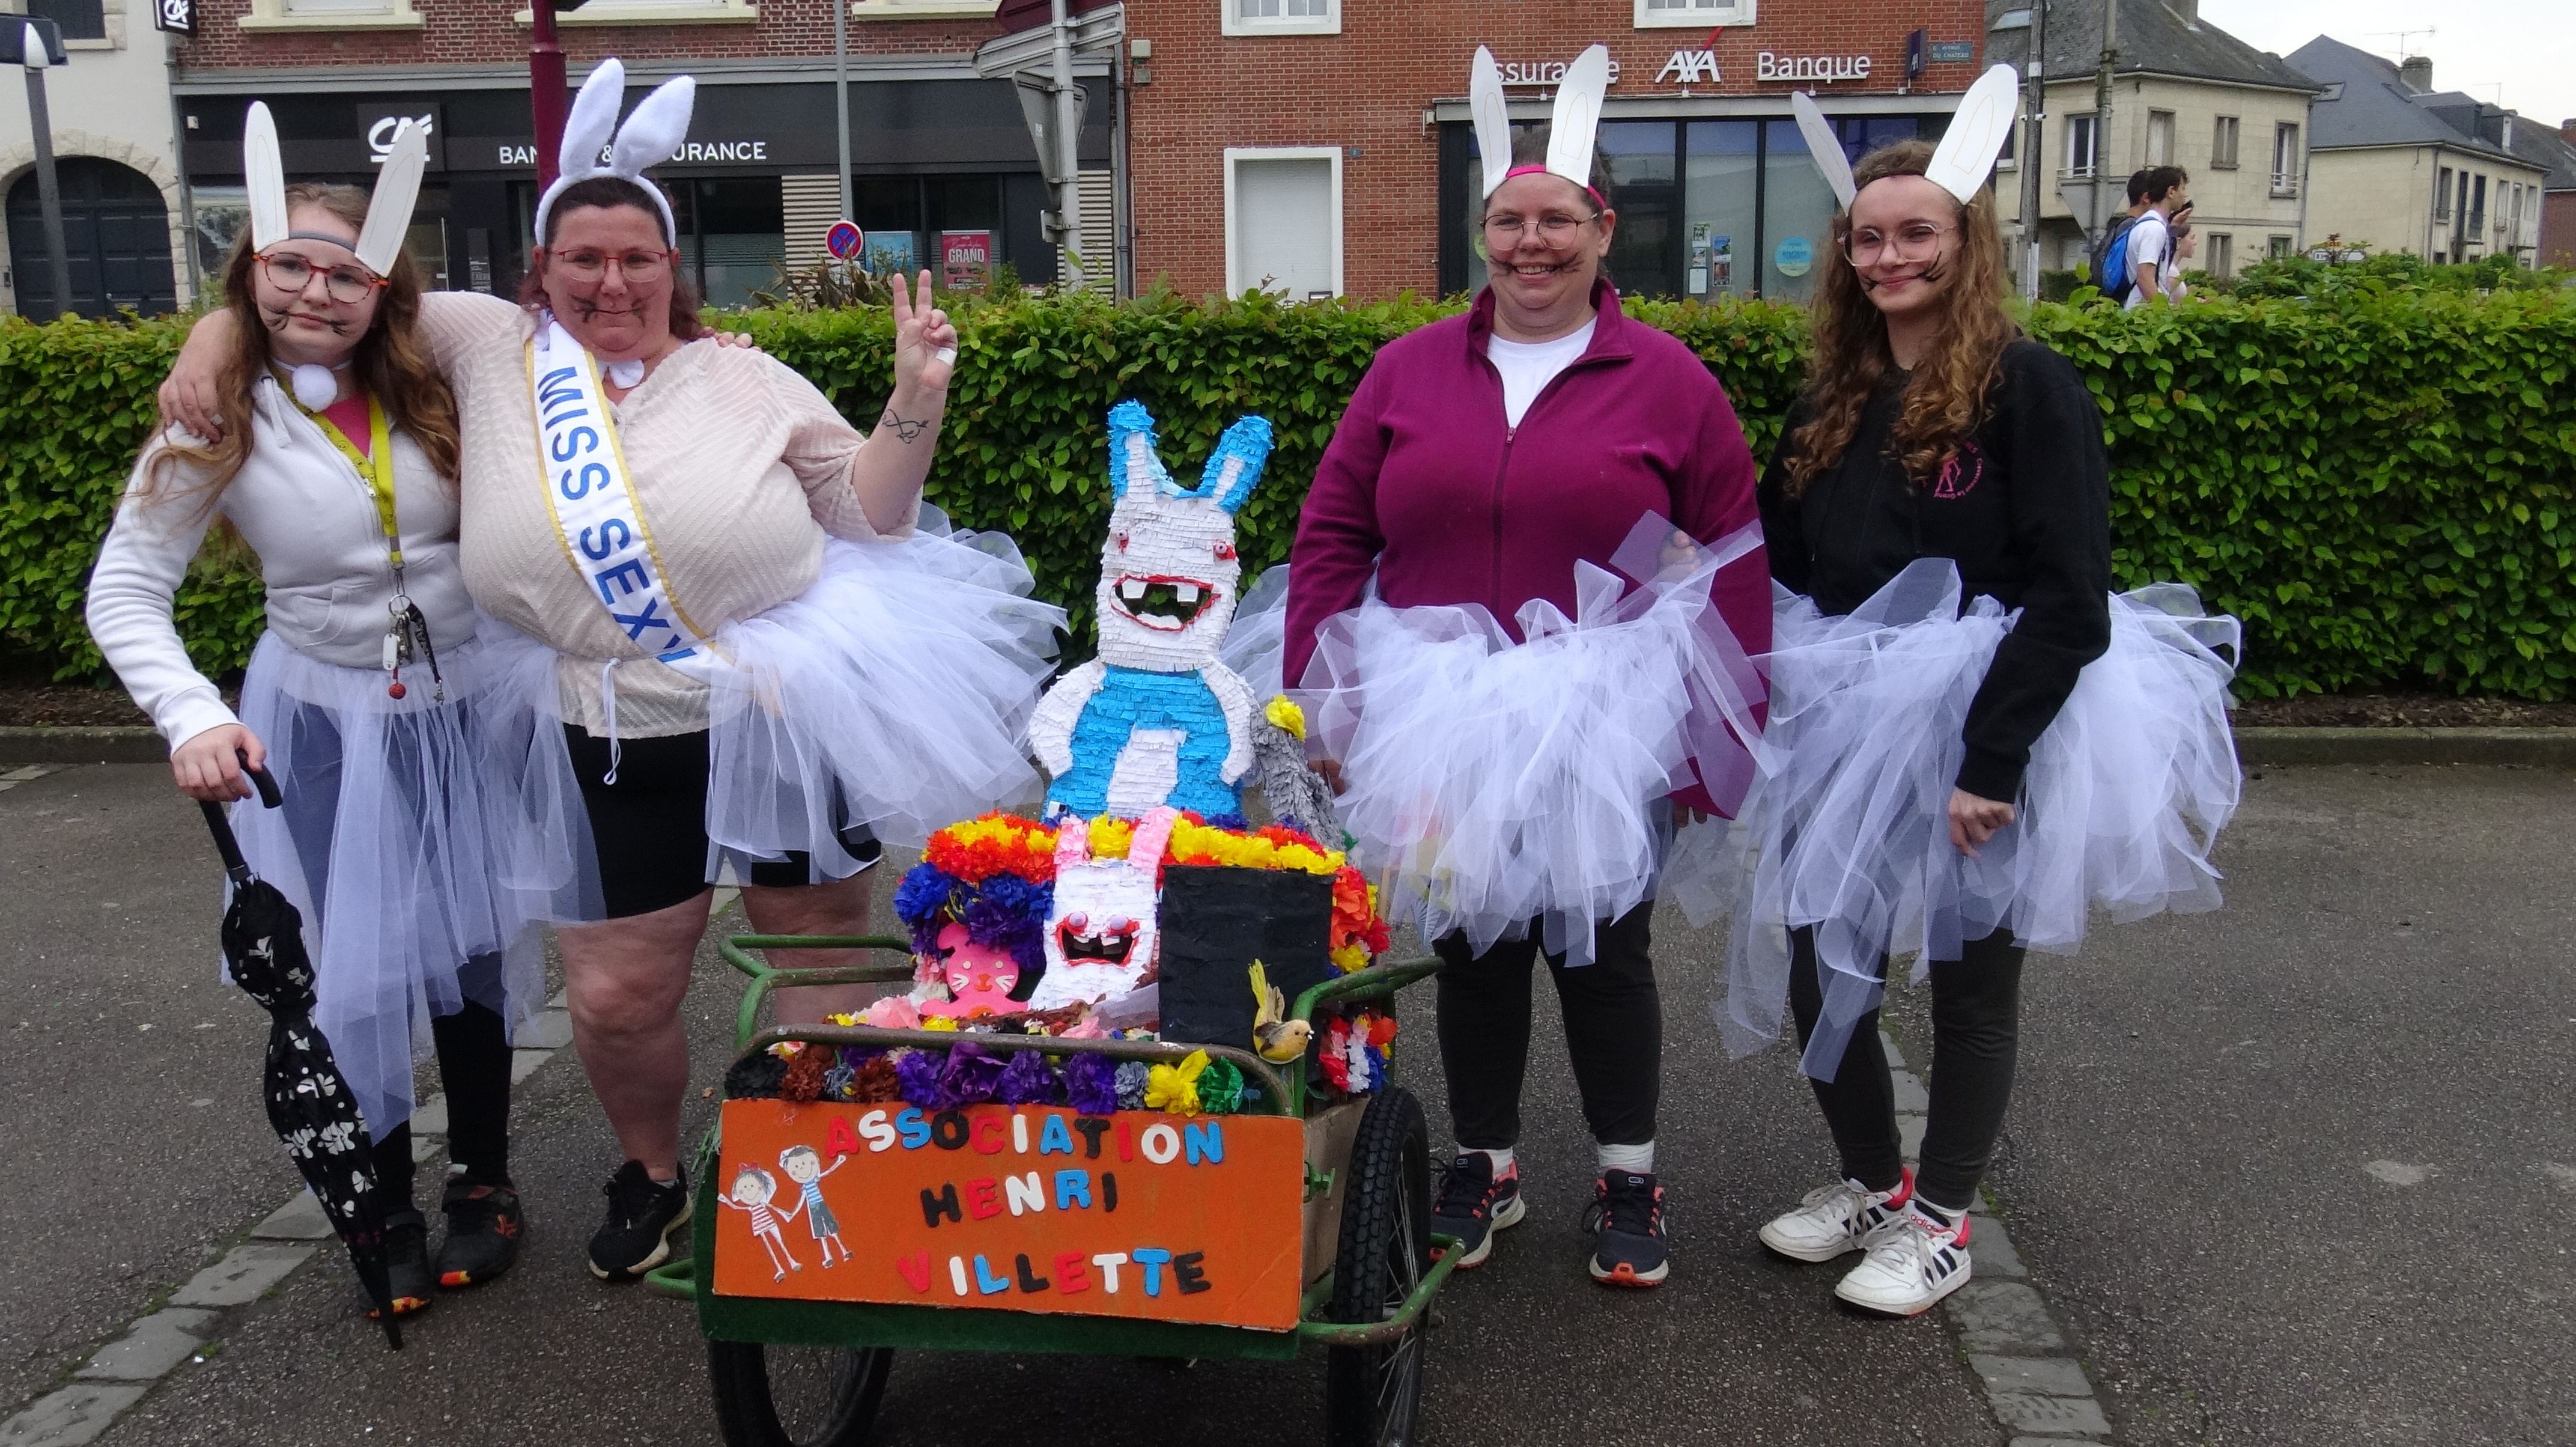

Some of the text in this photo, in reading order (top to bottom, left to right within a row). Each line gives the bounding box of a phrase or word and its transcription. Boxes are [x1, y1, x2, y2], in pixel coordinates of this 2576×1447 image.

[1495, 49, 1871, 84] ssurae AXA Banque
[499, 141, 767, 164] BAN & URANCE
[948, 248, 985, 263] GRAND
[538, 366, 611, 501] MISS
[825, 1106, 1224, 1165] ASSOCIATION
[919, 1169, 1117, 1228] HENRI
[1910, 1214, 1939, 1233] adida
[896, 1247, 1212, 1297] VILLETTE
